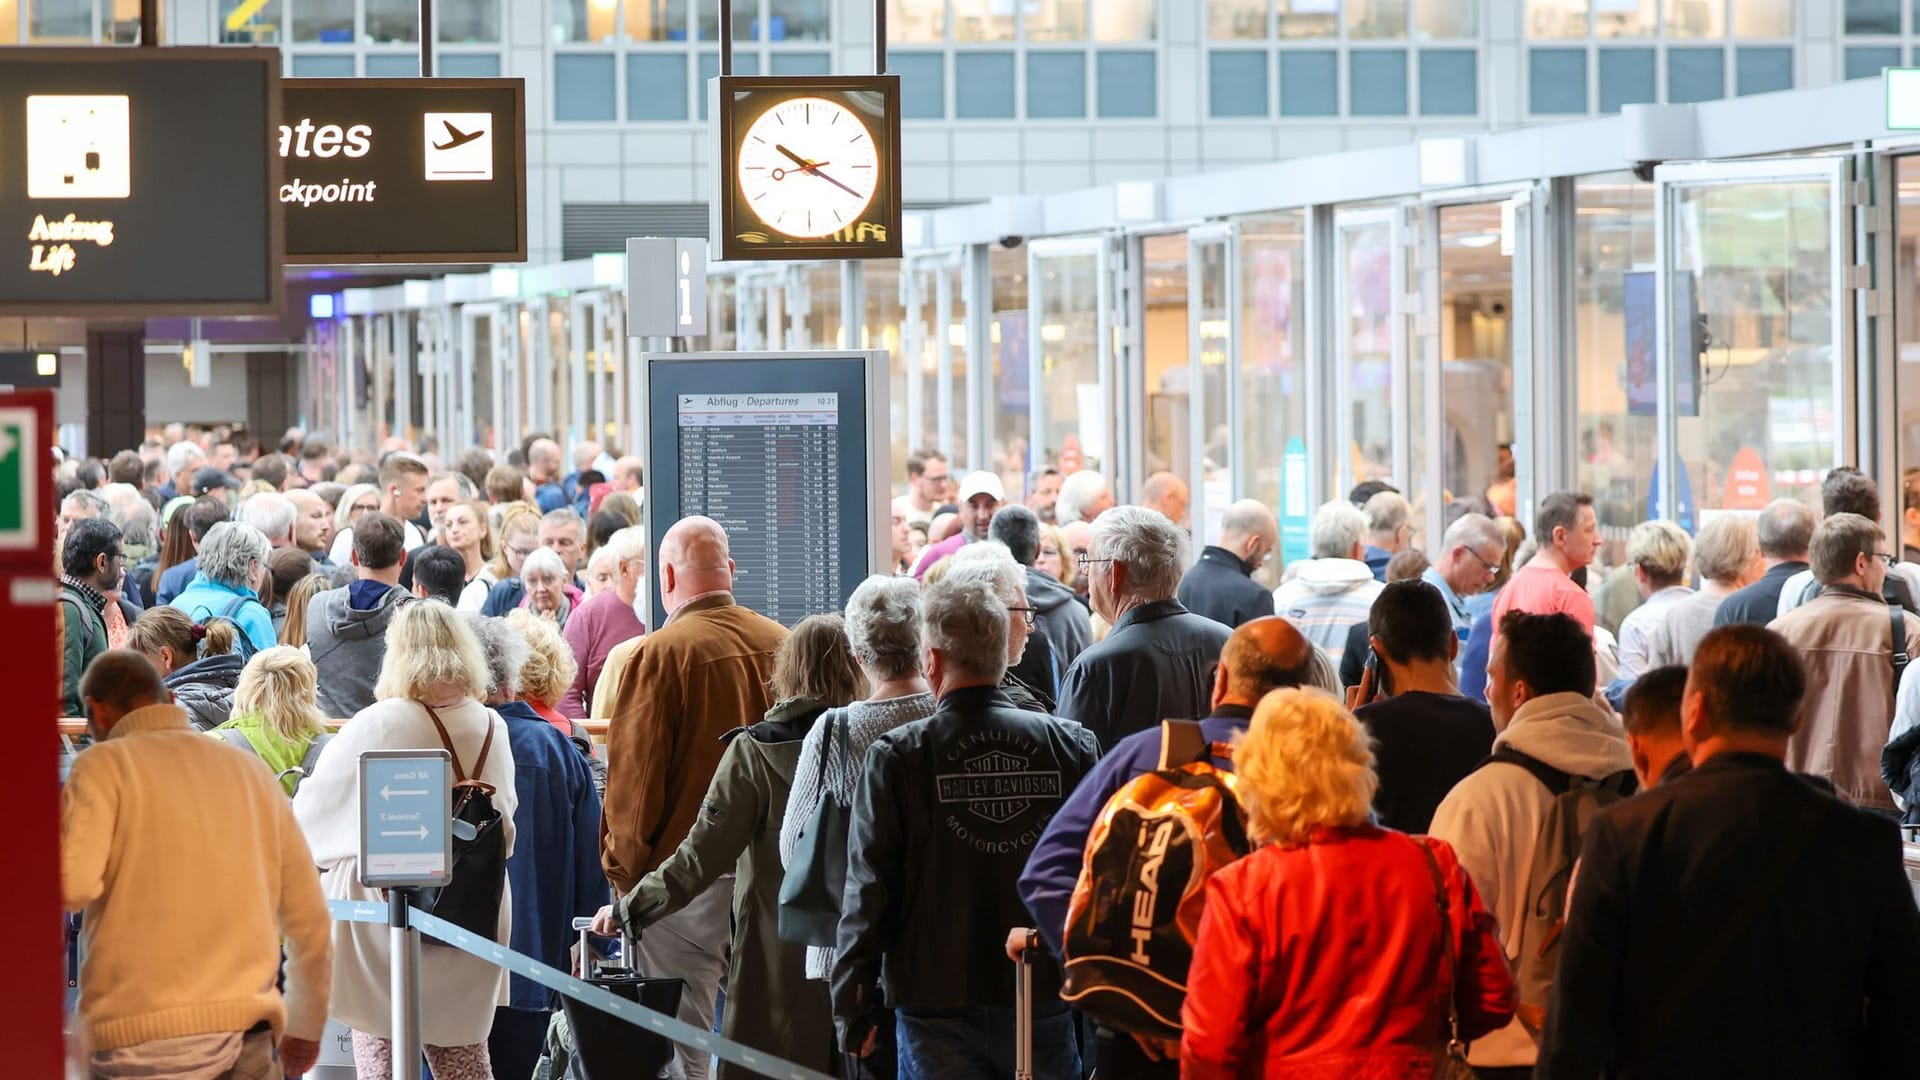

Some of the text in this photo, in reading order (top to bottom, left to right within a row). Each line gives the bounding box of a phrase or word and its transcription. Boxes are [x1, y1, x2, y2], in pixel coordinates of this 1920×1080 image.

[29, 243, 76, 276] Lift
[707, 396, 738, 408] Abflug
[747, 396, 799, 407] Departures
[972, 754, 1021, 772] MOTOR
[943, 776, 1057, 798] HARLEY-DAVIDSON
[974, 800, 1024, 818] CYCLES
[1130, 821, 1174, 966] HEAD
